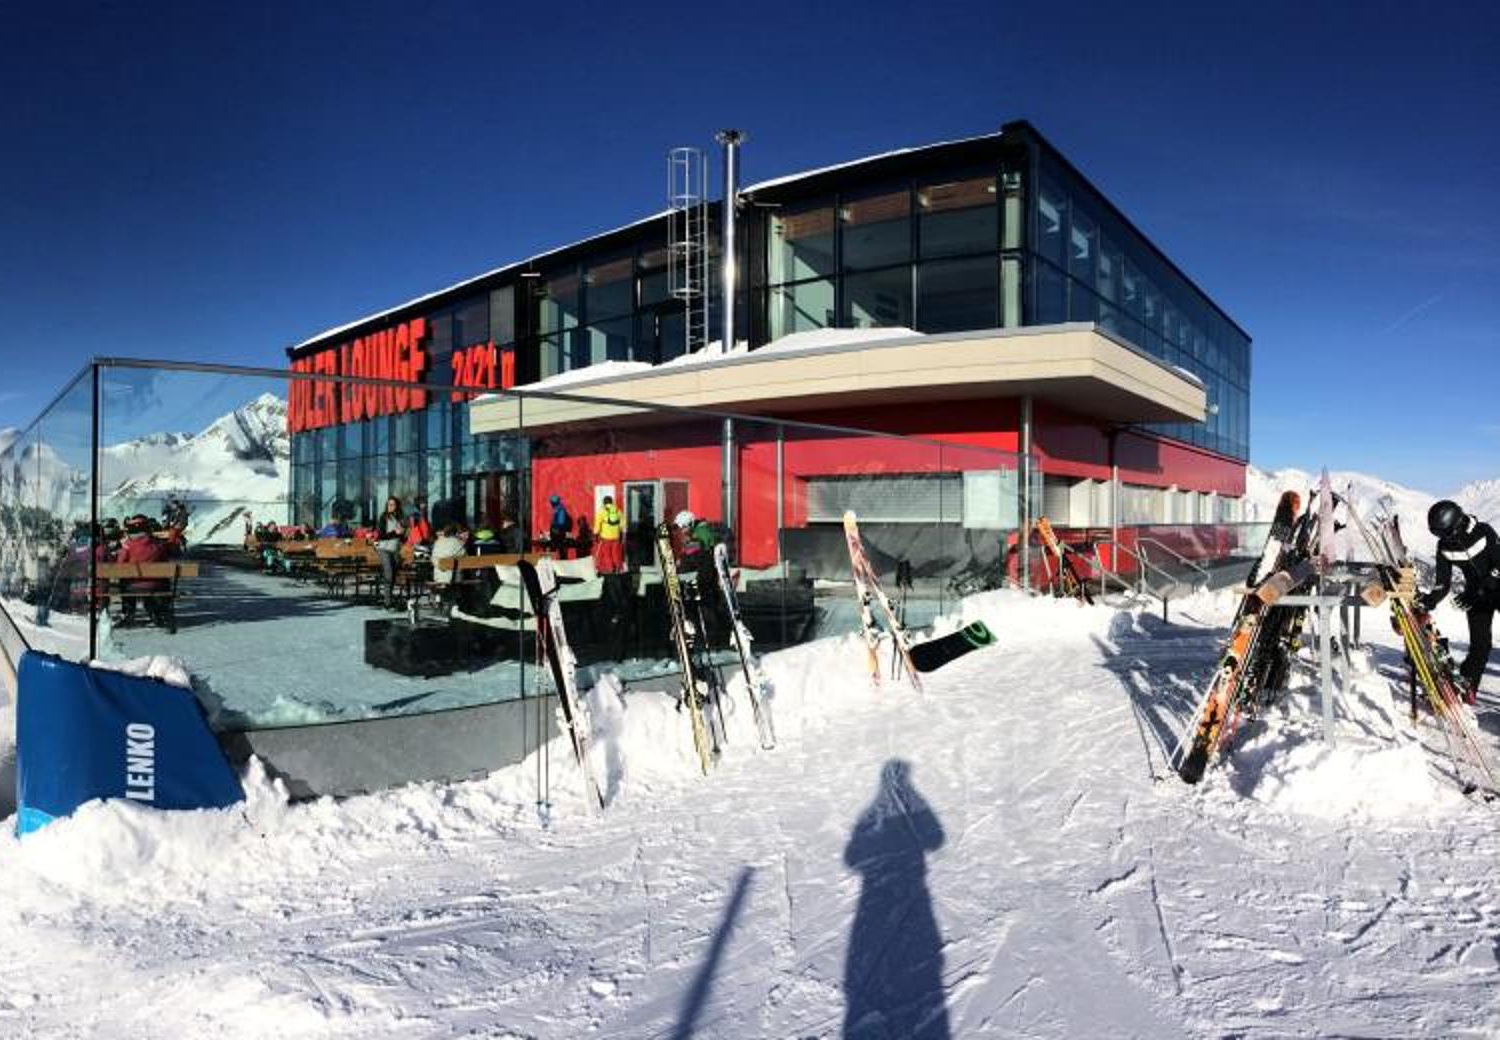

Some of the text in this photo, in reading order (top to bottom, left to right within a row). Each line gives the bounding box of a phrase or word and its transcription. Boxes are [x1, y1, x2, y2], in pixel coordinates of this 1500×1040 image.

[341, 318, 426, 424] LOUNGE
[451, 338, 497, 403] 2421
[125, 722, 155, 801] LENKO
